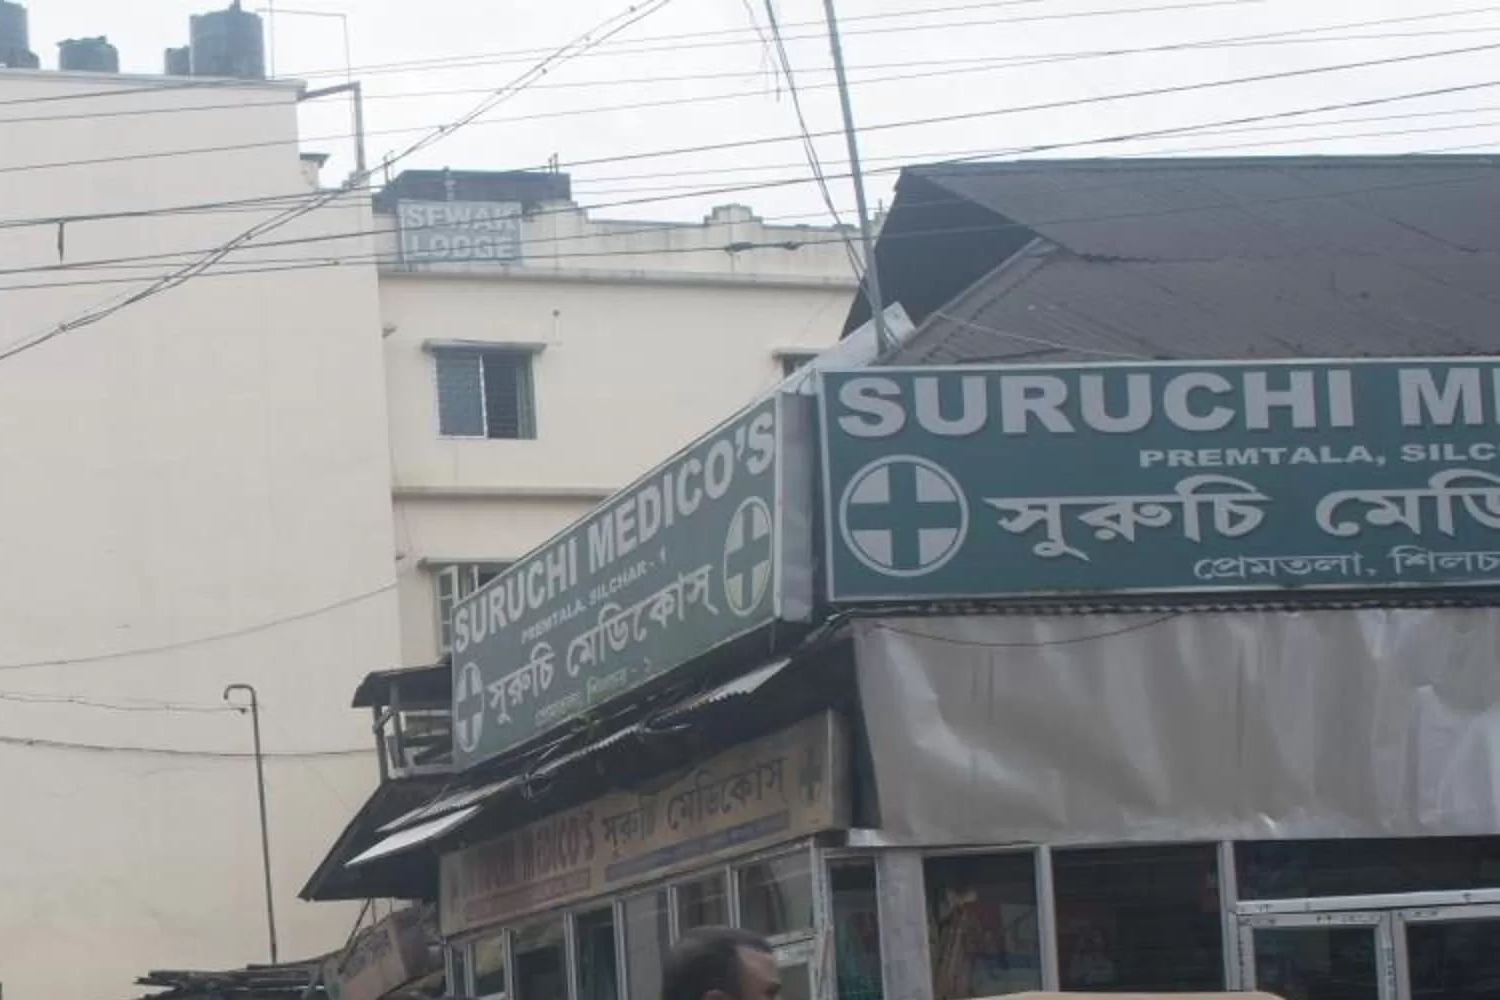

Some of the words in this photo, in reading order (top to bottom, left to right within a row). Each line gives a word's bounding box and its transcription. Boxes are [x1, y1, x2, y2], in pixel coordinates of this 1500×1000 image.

[411, 234, 514, 259] LODGE
[836, 368, 1357, 438] SURUCHI
[1398, 367, 1500, 427] M
[1139, 445, 1386, 468] PREMTALA,
[454, 536, 578, 653] SURUCHI
[587, 411, 775, 575] MEDICO'S
[982, 474, 1274, 562] সুরুচি
[484, 642, 557, 725] সুরুচি
